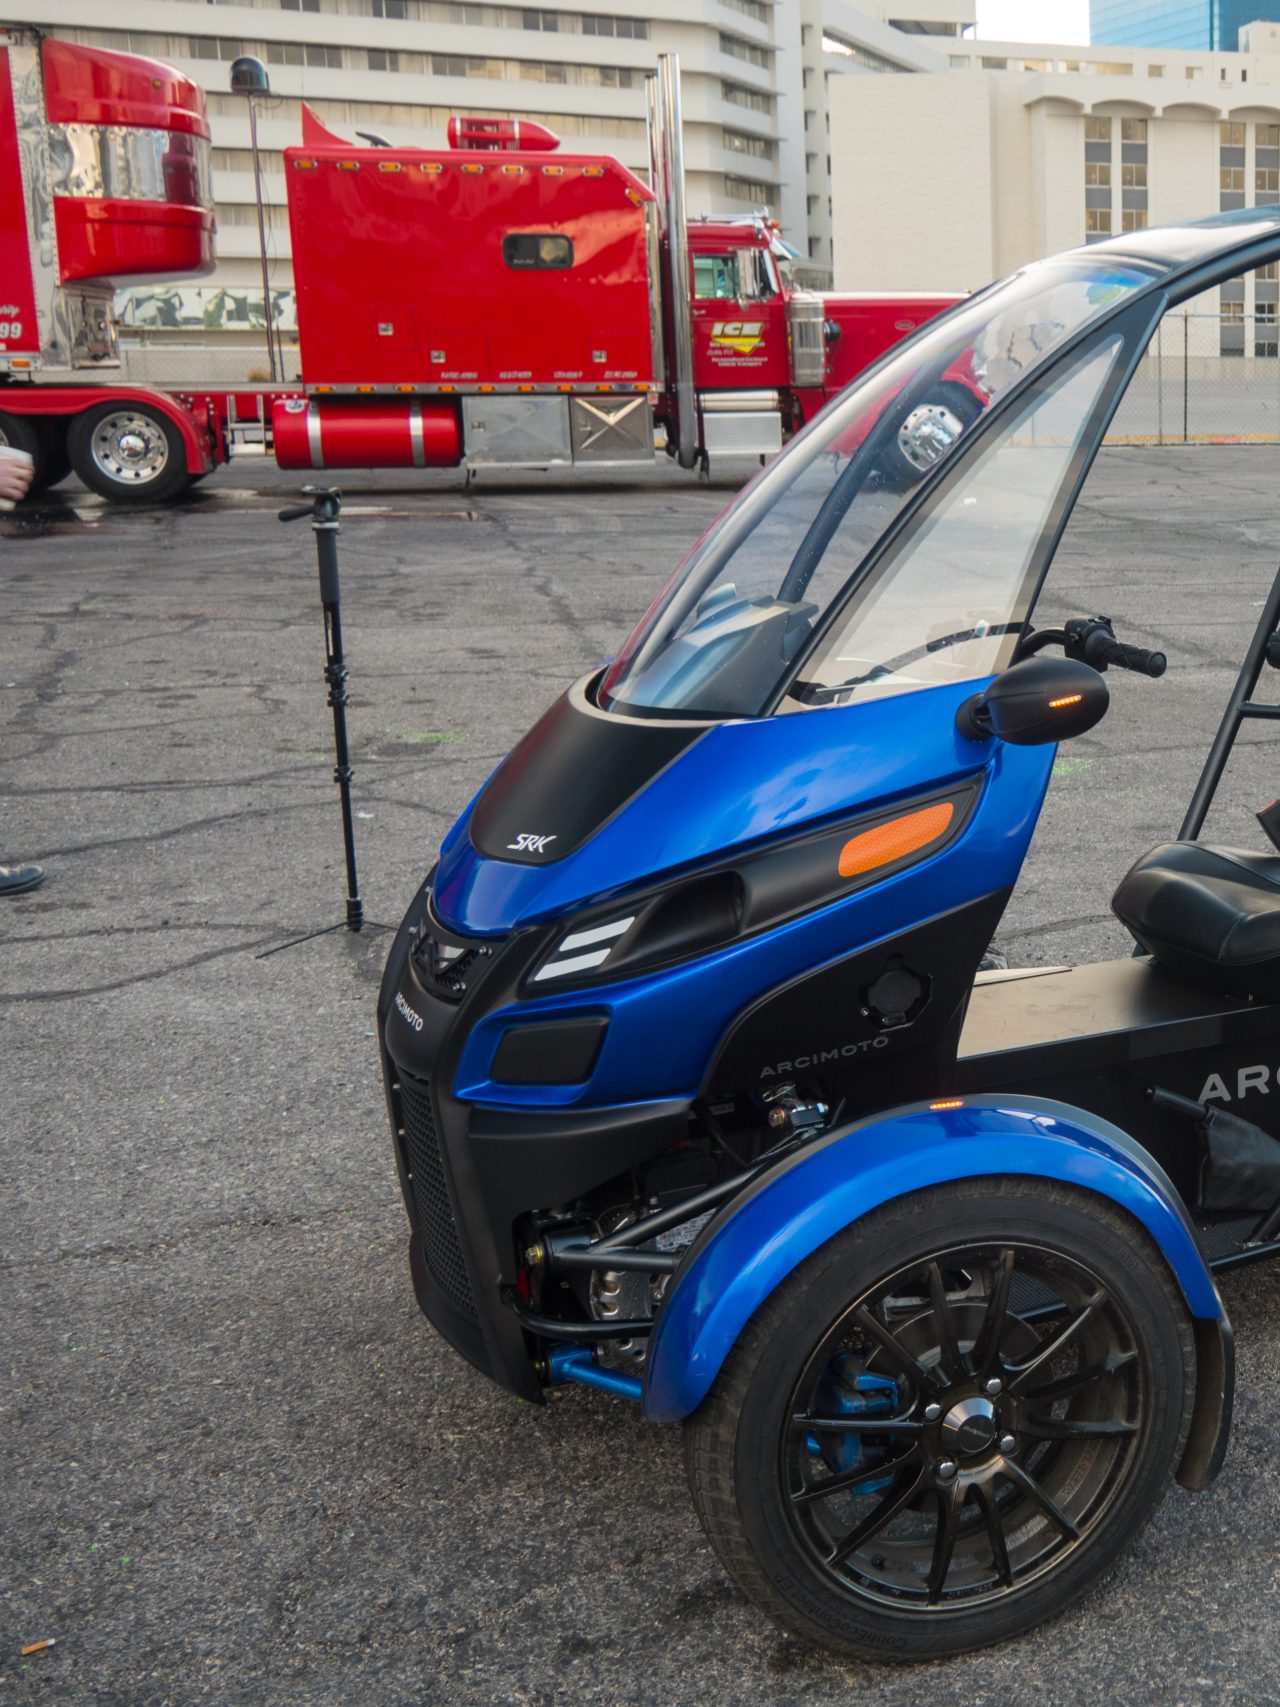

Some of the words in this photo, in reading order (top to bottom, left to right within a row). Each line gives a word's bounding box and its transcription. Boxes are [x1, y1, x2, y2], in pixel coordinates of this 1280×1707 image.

[712, 321, 762, 336] ICE
[506, 833, 557, 853] SRK
[395, 991, 424, 1032] ARCIMOTO
[759, 1036, 890, 1079] ARCIMOTO
